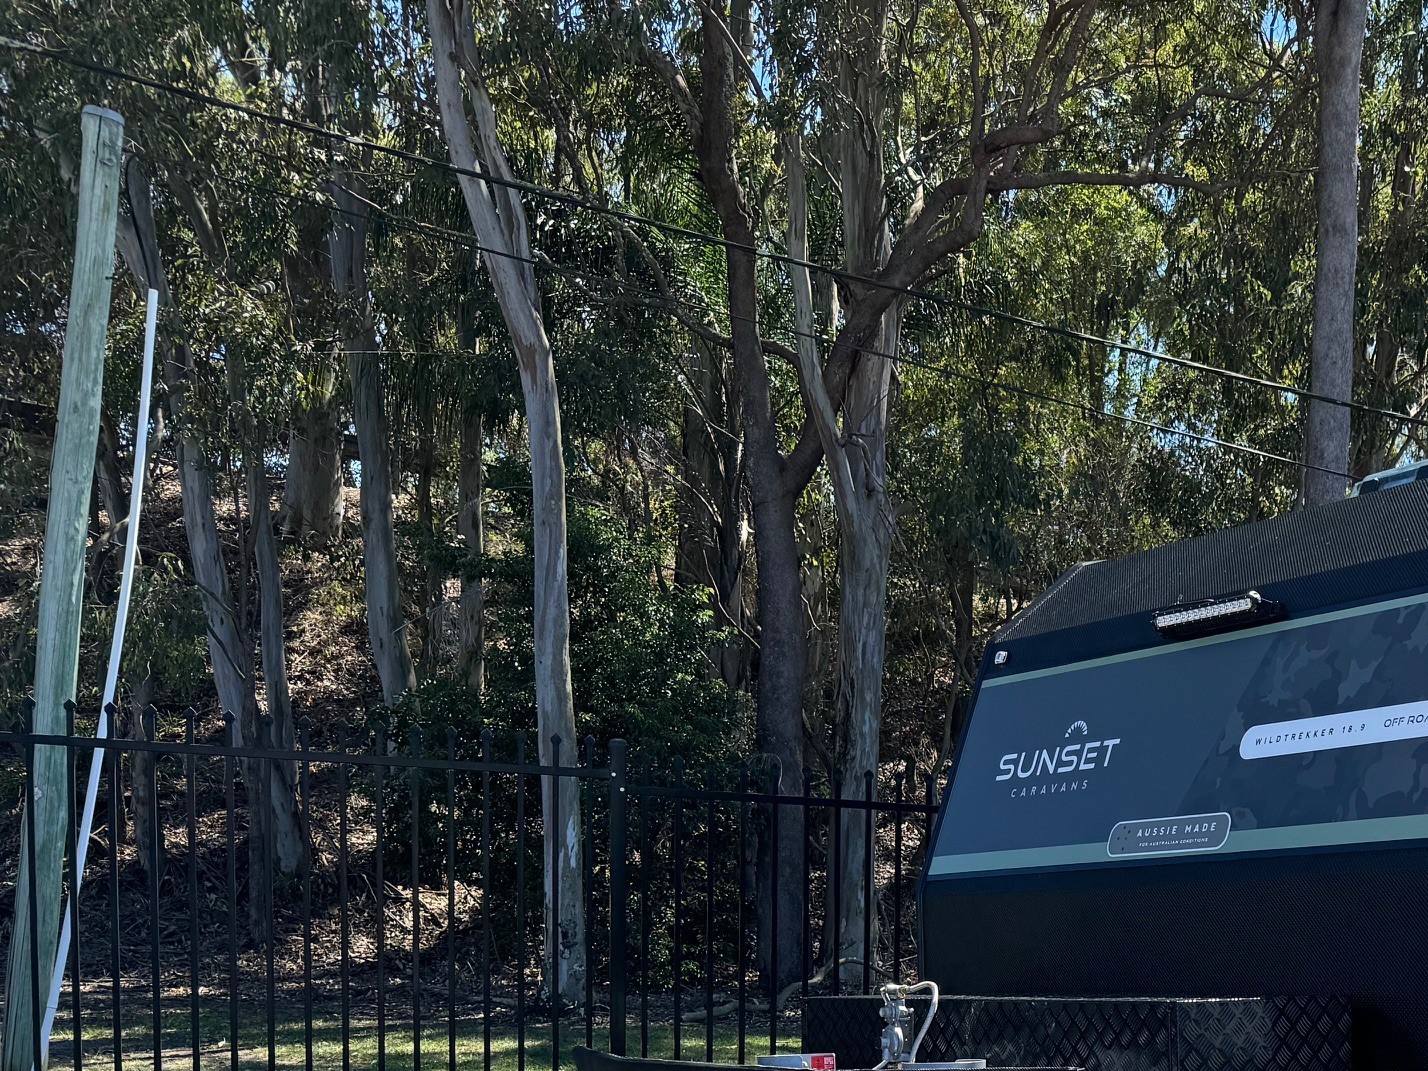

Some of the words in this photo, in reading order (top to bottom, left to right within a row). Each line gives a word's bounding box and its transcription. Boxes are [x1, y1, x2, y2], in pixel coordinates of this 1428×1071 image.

[1255, 728, 1335, 746] WILDTREKKER
[1341, 723, 1366, 734] 18.9
[1383, 718, 1405, 728] OFF
[995, 738, 1121, 781] SUNSET
[1010, 780, 1088, 798] CARAVANS
[1136, 825, 1178, 838] AUSSIE
[1184, 822, 1217, 834] MADE
